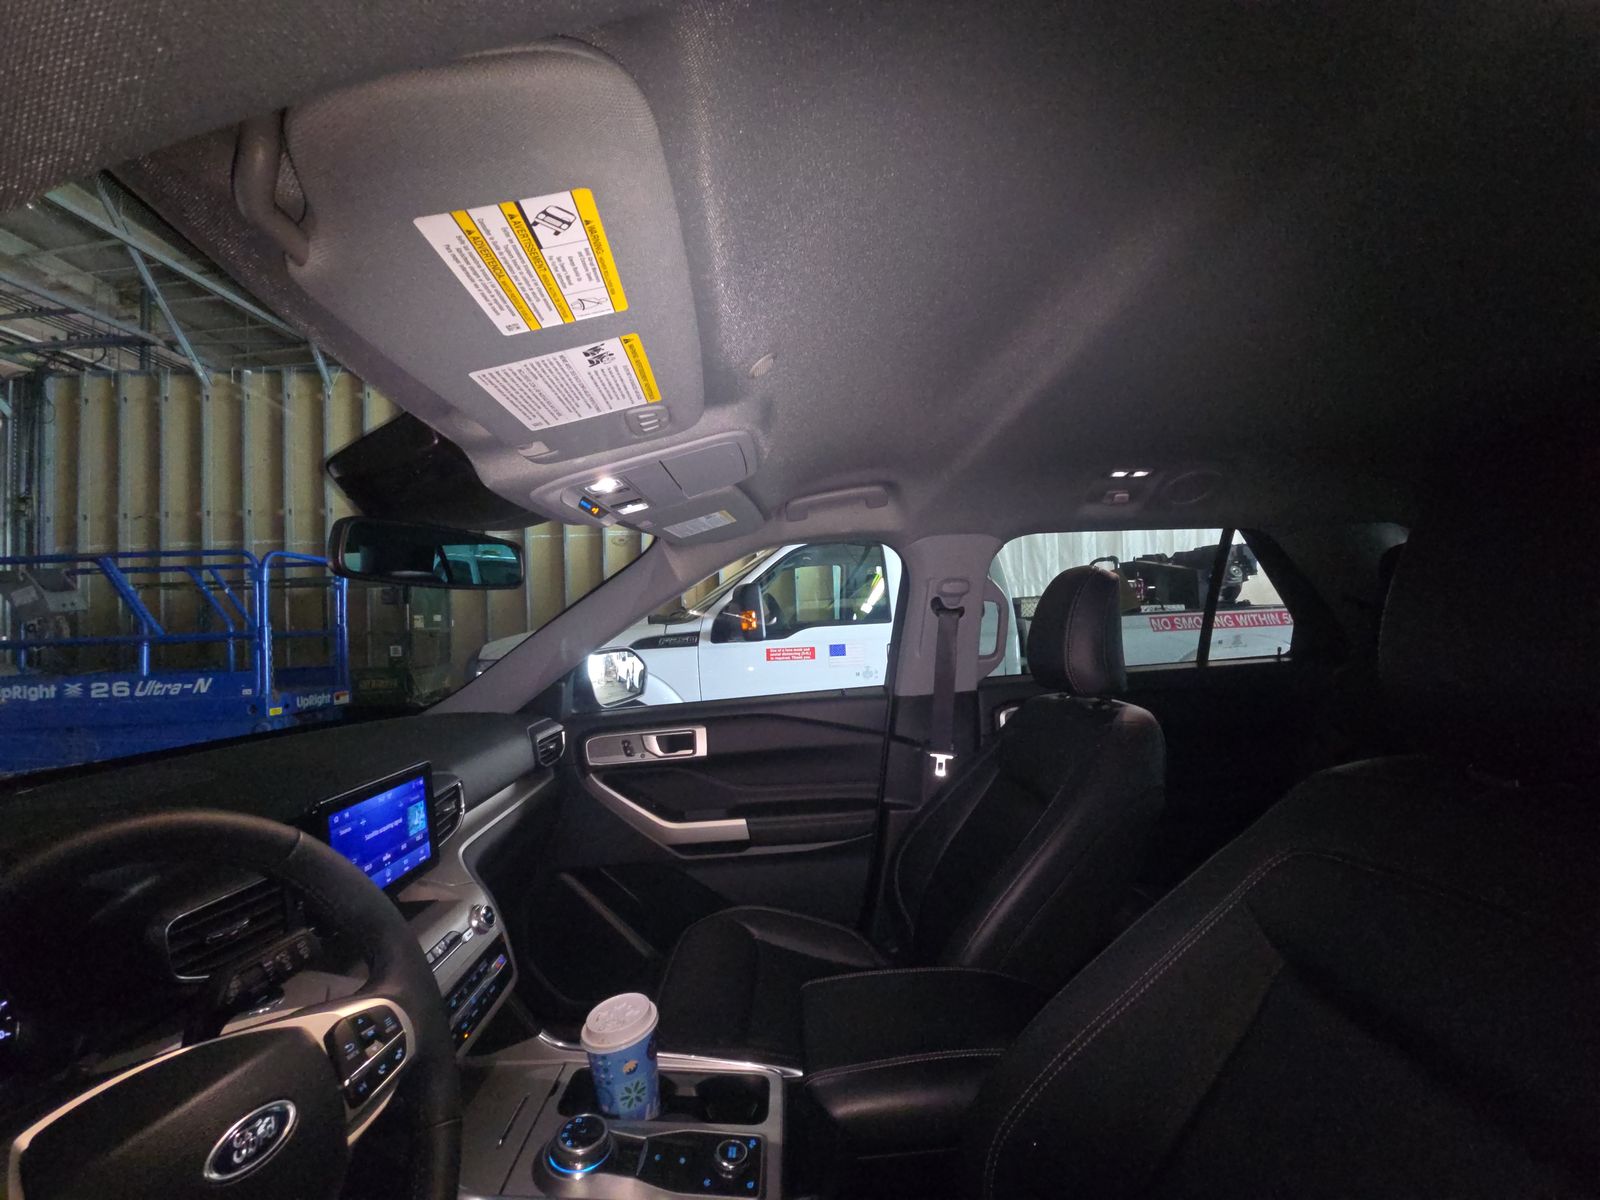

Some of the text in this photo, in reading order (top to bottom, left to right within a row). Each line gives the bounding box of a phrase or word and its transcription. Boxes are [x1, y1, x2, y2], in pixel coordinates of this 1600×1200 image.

[510, 219, 546, 272] AVERTISSEMENT:
[586, 224, 604, 254] WARNING:
[469, 235, 506, 279] ADVERTENCIA:
[1151, 618, 1171, 630] NO
[1174, 614, 1234, 630] SMOING
[1235, 612, 1280, 626] WITHIN
[0, 678, 213, 701] pRight 26 Ultra-N
[296, 693, 331, 710] UpRight
